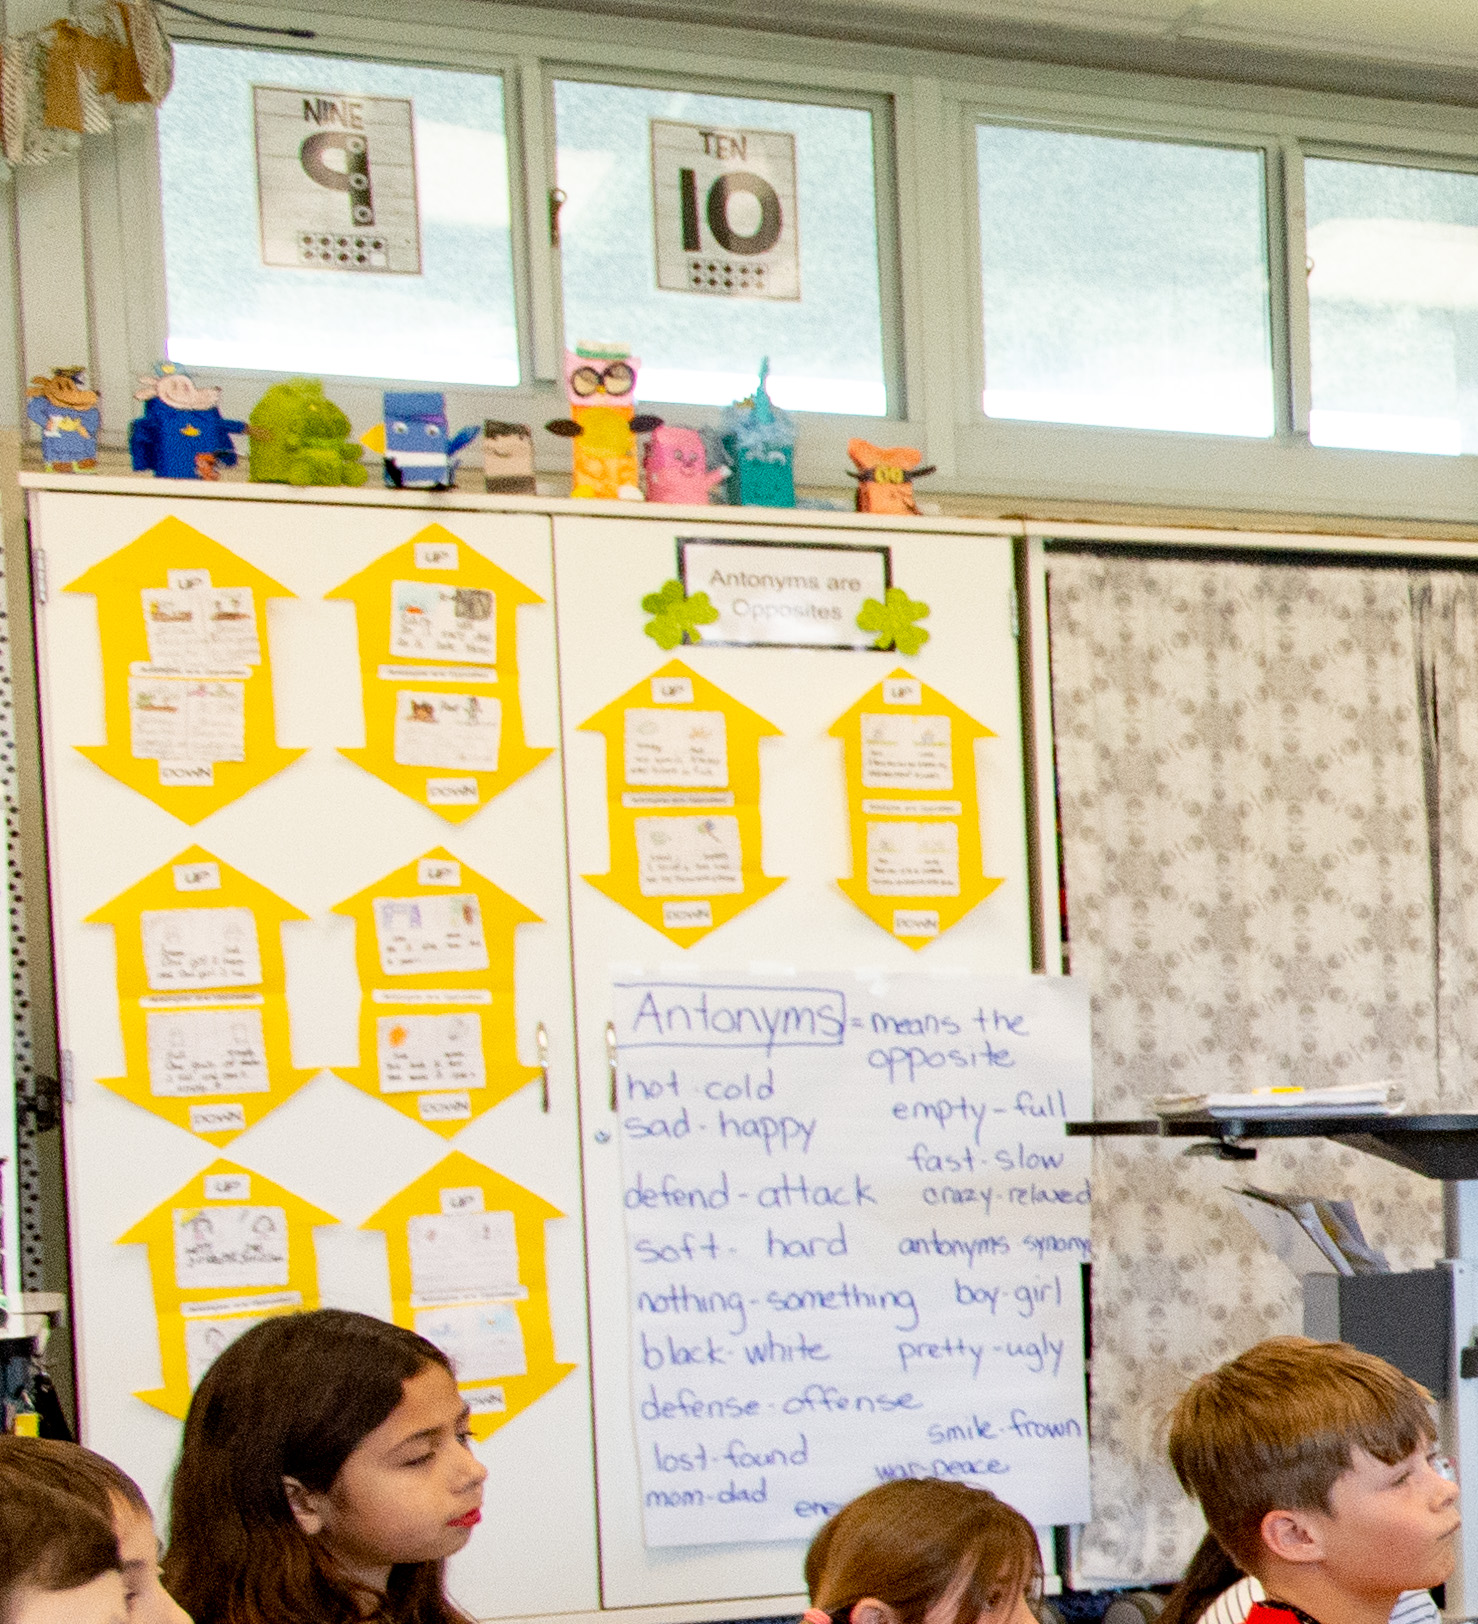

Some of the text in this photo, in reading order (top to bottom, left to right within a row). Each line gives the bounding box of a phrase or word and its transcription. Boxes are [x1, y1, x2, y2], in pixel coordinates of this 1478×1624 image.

[303, 98, 364, 130] NINE
[699, 132, 747, 161] TEN
[301, 131, 375, 227] 9
[680, 167, 783, 256] 10
[709, 568, 861, 594] Antonyms are
[733, 598, 842, 621] Opposites
[632, 991, 844, 1057] Antonyms
[871, 1013, 962, 1036] means
[974, 1007, 1030, 1036] the
[868, 1043, 1015, 1084] opposite
[627, 1067, 774, 1101] hot cold
[634, 1222, 848, 1263] soft hard
[899, 1228, 1009, 1269] antonyms
